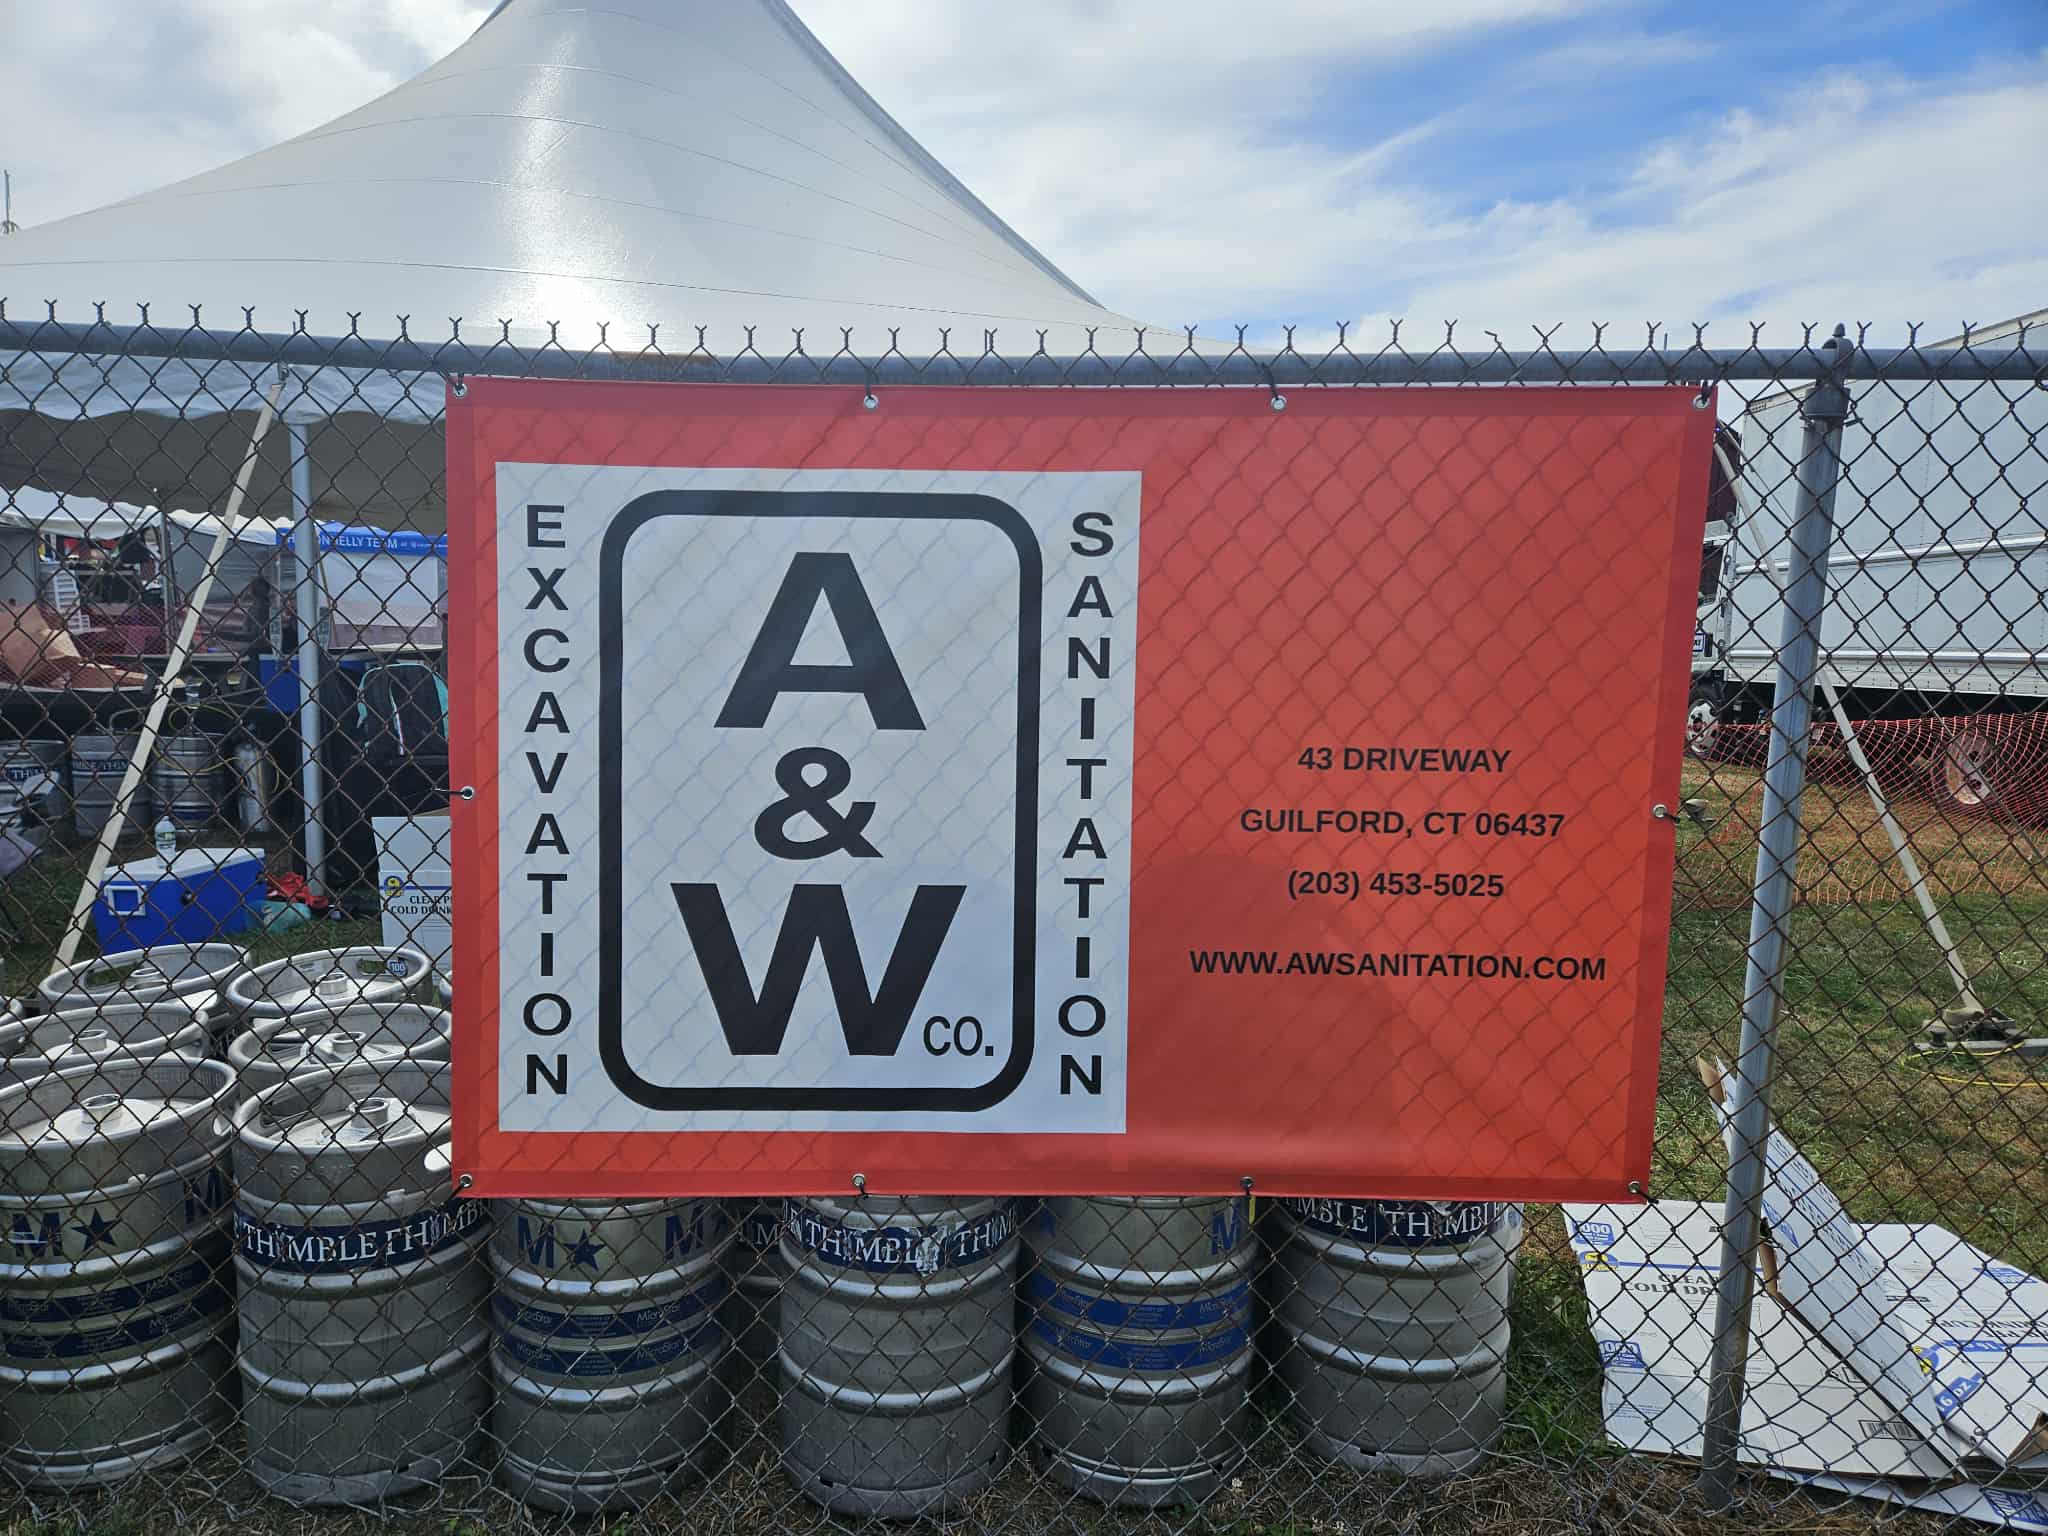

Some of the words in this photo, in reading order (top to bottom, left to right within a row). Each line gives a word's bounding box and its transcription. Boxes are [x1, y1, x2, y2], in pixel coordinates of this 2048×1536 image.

[713, 552, 927, 731] A
[523, 504, 572, 1095] EXCAVATION
[754, 746, 883, 860] &
[1058, 511, 1114, 1095] SANITATION
[1297, 747, 1333, 770] 43
[1343, 748, 1511, 772] DRIVEWAY
[1240, 808, 1413, 838] GUILFORD,
[1423, 812, 1466, 834] CT
[1475, 812, 1565, 836] 06437
[1288, 870, 1360, 900] (203)
[1369, 873, 1504, 897] 453-5025
[670, 882, 968, 1056] W
[923, 1015, 994, 1057] CO.
[1190, 950, 1606, 980] WWW.AWSANITATION.COM
